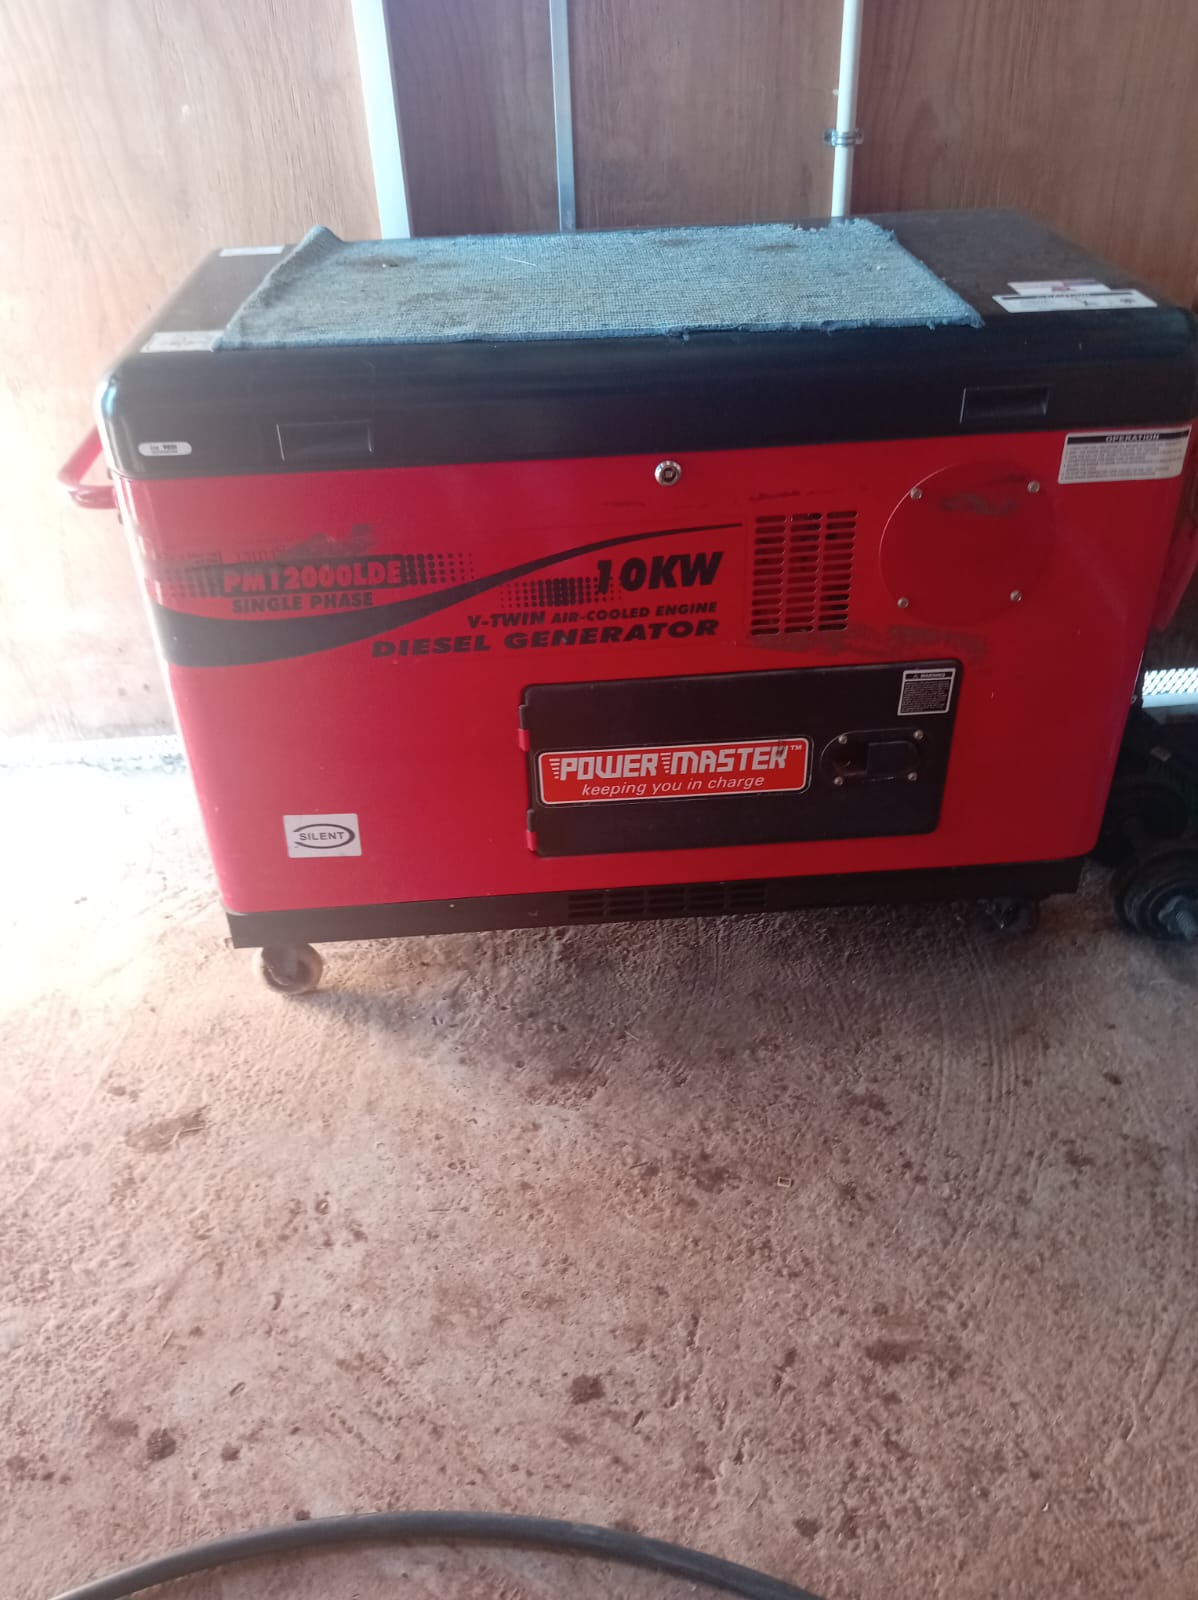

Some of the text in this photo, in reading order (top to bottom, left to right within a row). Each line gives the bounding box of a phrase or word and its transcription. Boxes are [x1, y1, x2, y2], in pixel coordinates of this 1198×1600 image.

[1105, 432, 1160, 443] OPERATION
[596, 551, 724, 594] 10KW
[231, 592, 373, 614] SINGLE PHASE
[467, 602, 718, 629] V-TWIN AIR-COOLED ENGINE
[371, 619, 719, 658] DIESEL GENERATOR
[559, 753, 658, 781] POWER
[581, 776, 765, 797] keeping you in charge
[299, 831, 345, 841] SILENT
